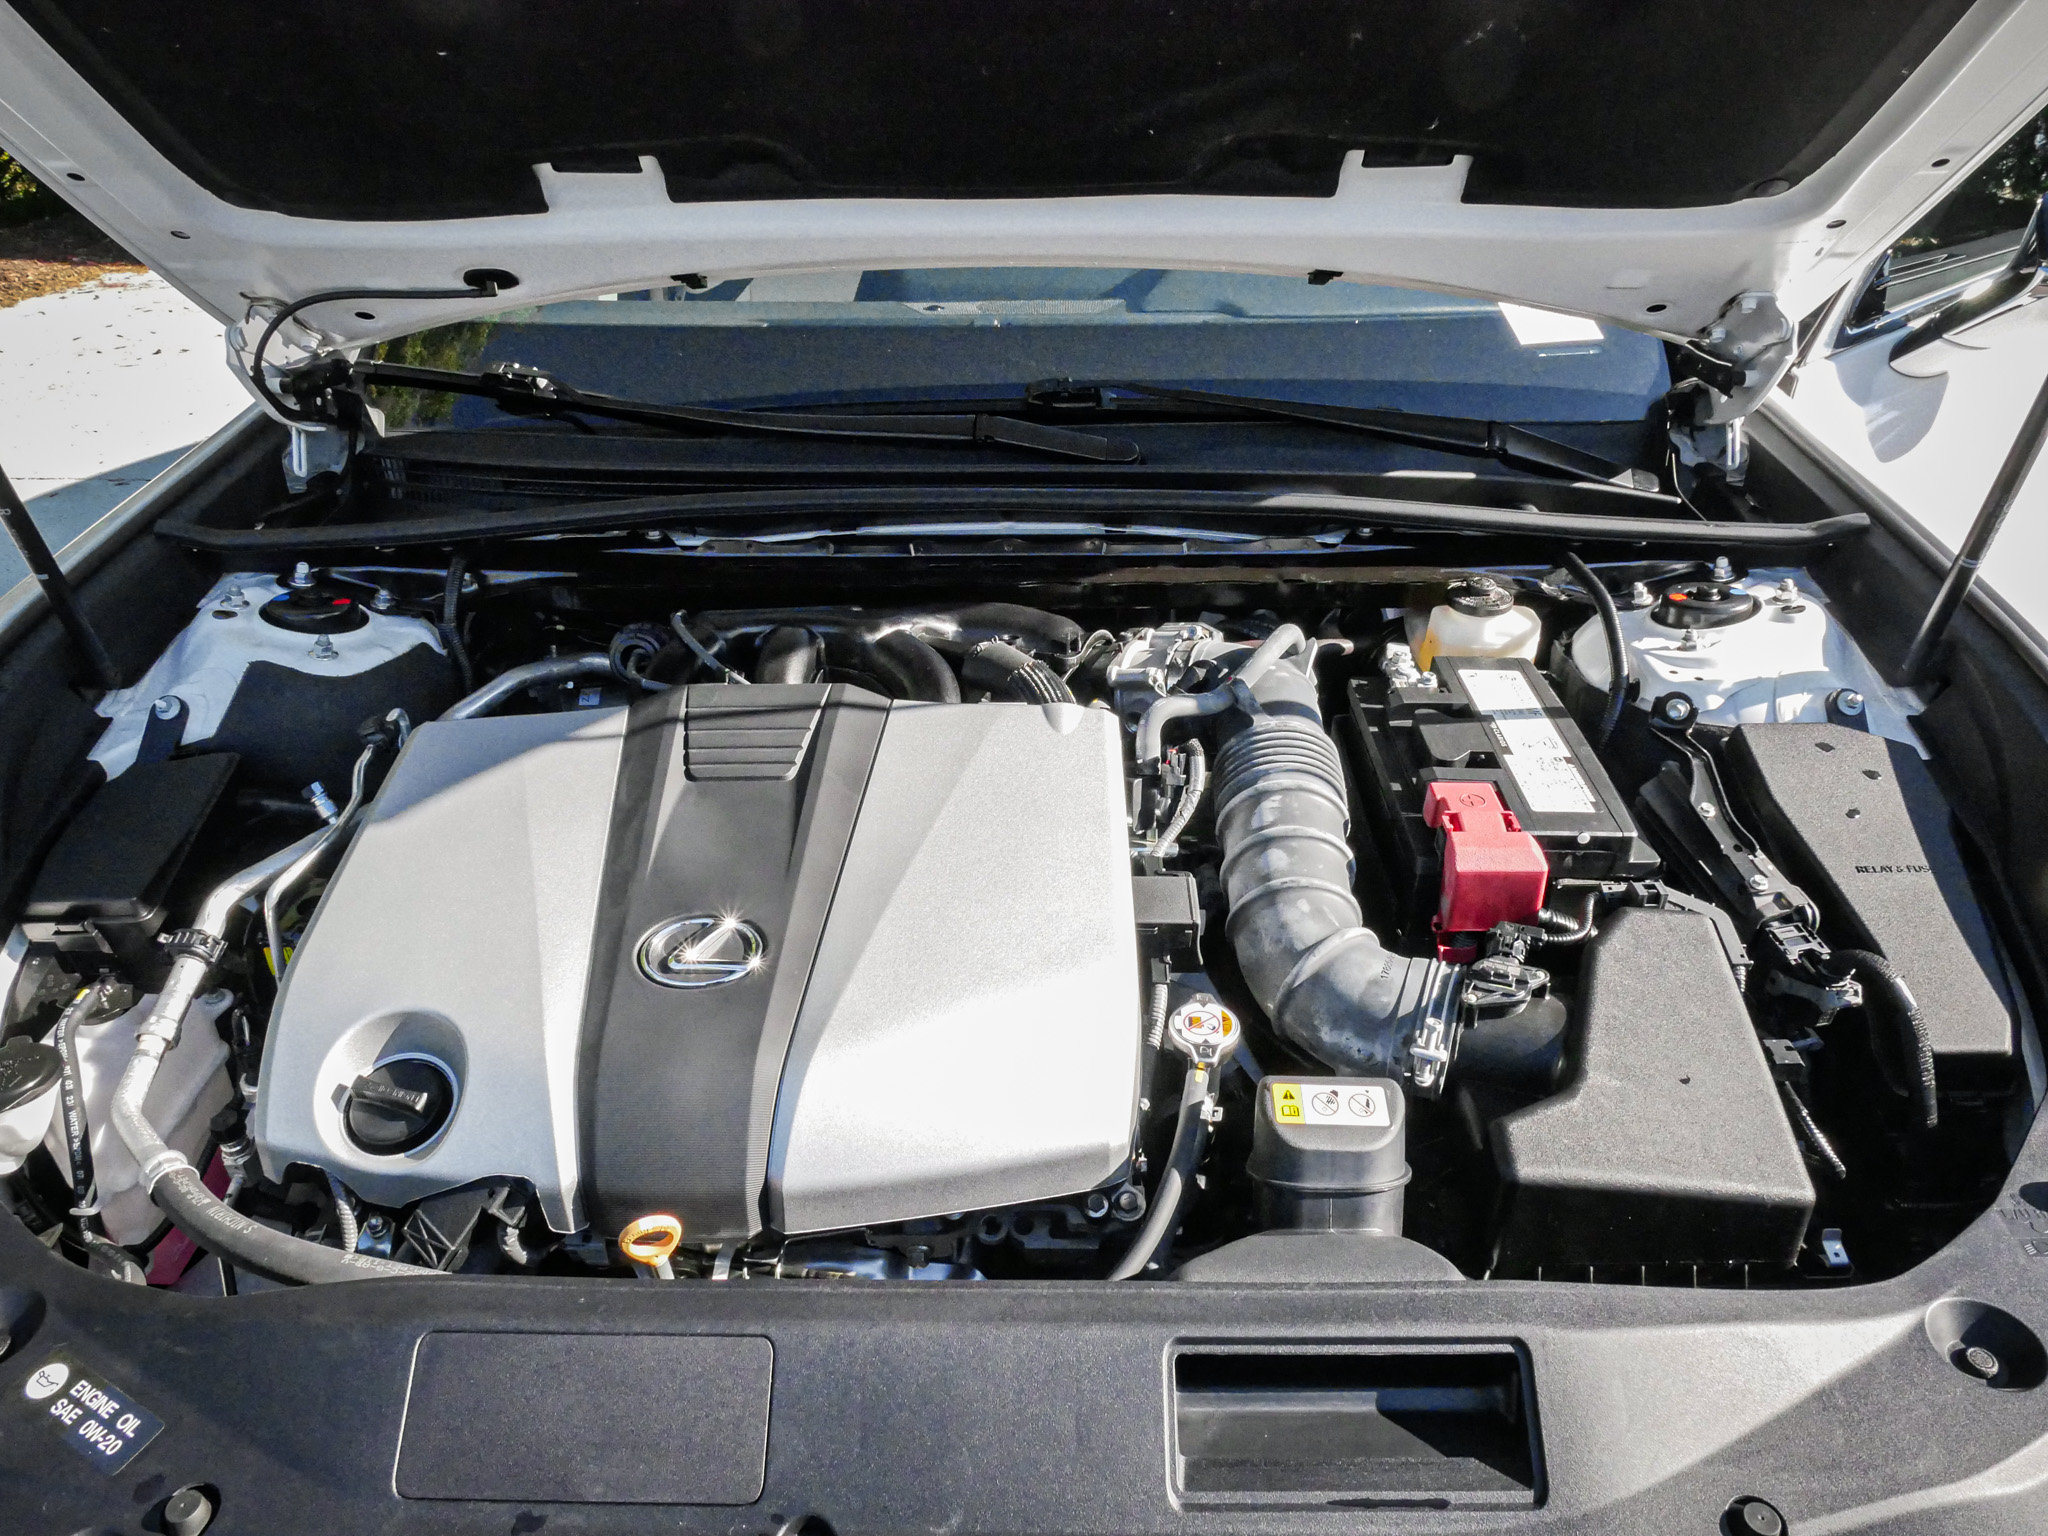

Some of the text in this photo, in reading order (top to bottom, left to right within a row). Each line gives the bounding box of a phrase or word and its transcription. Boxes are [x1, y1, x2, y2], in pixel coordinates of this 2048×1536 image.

[1855, 865, 1893, 874] RELAY
[68, 1110, 80, 1137] WATER
[49, 1398, 123, 1456] SAE 0W-20
[69, 1379, 142, 1438] ENGINE OIL
